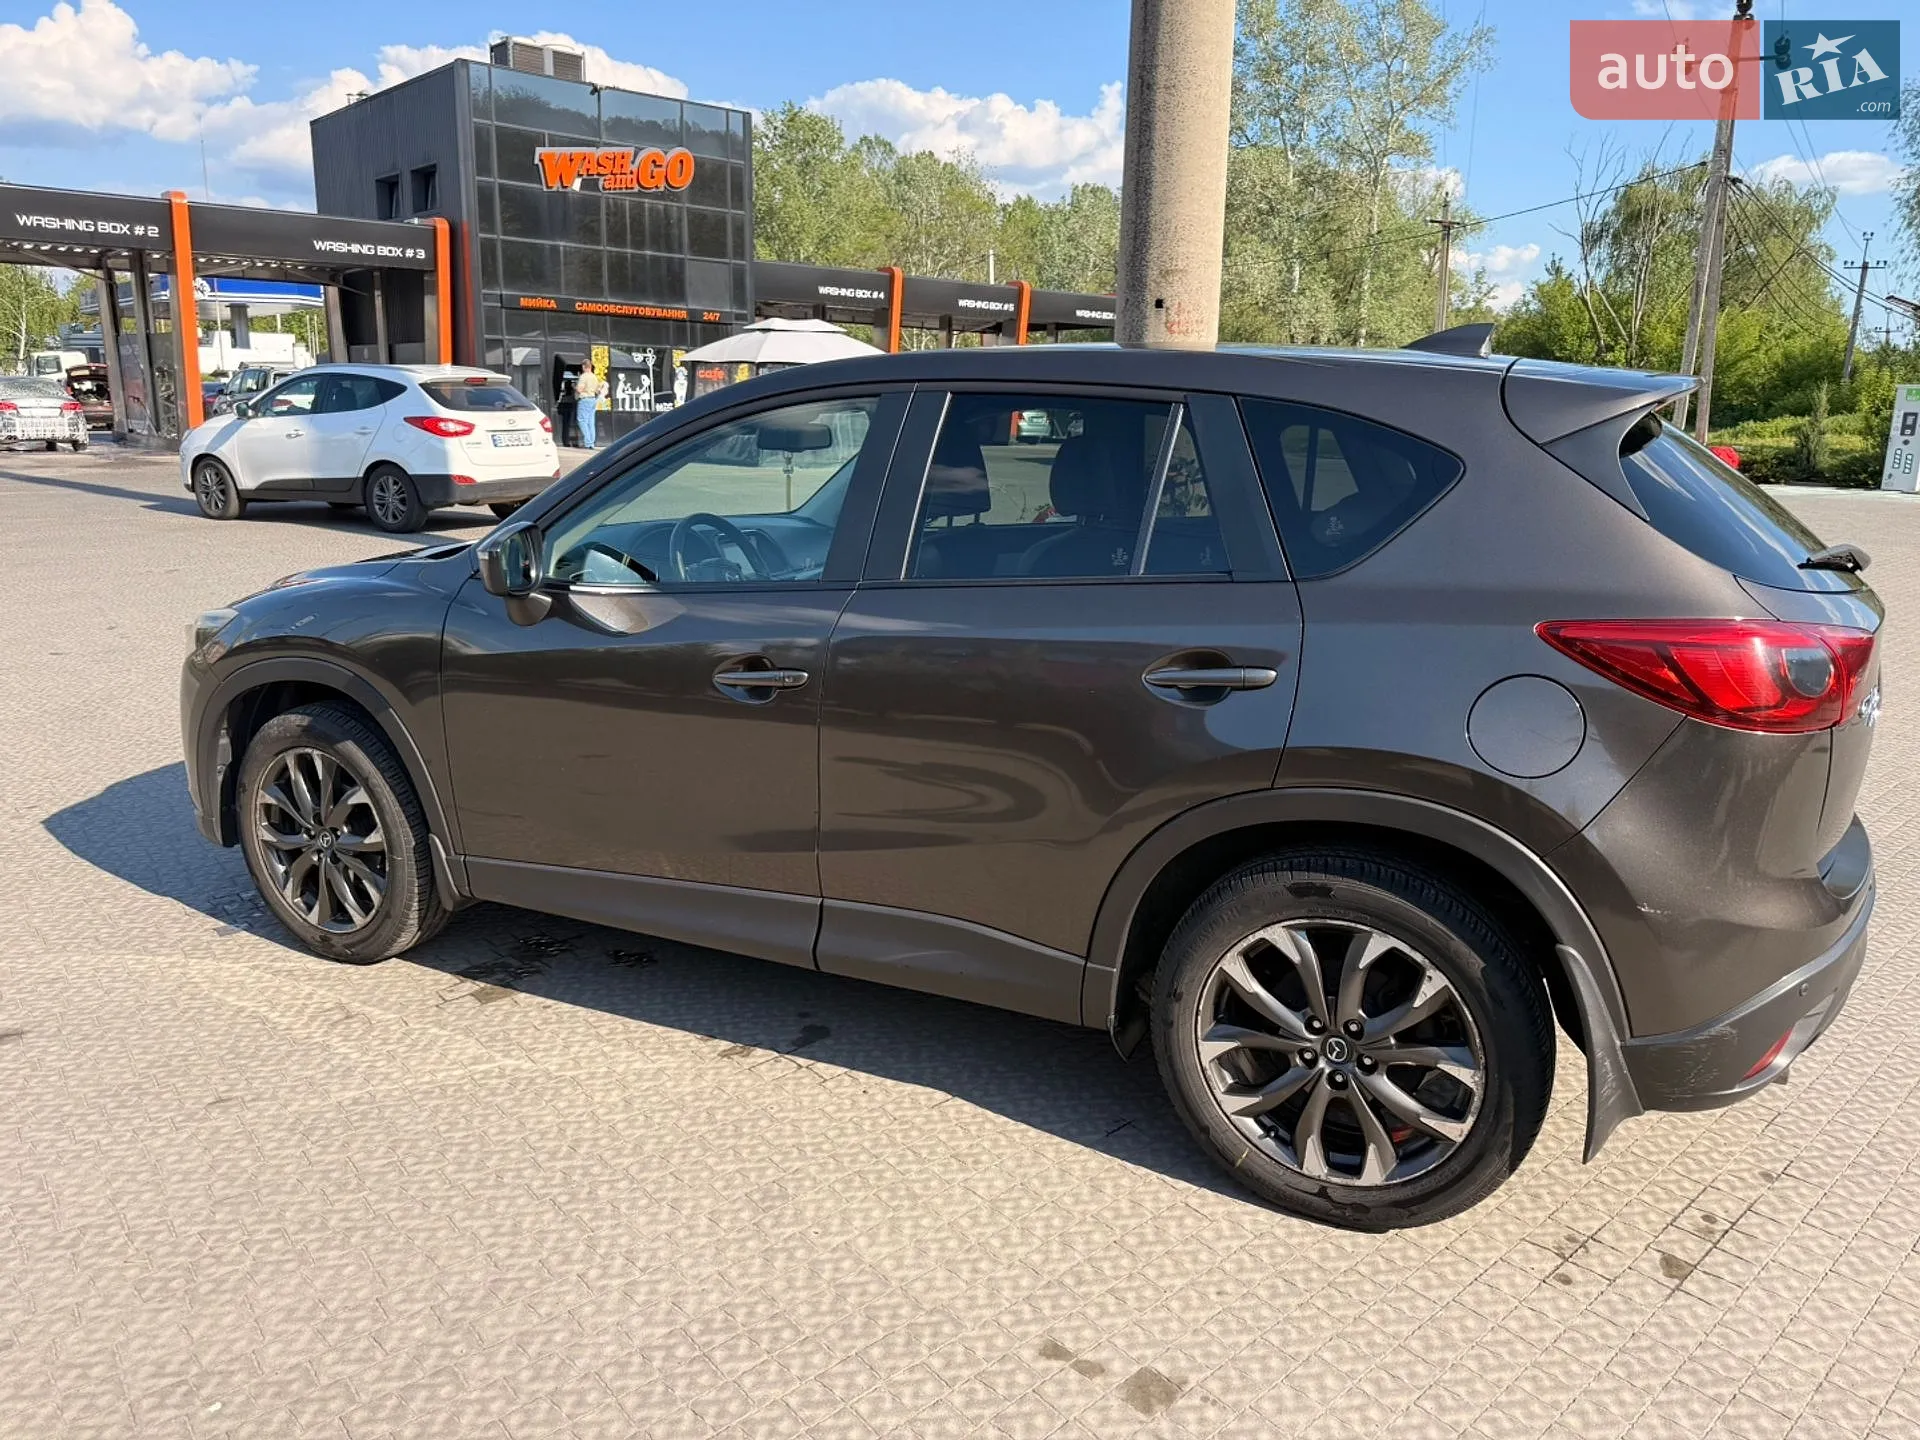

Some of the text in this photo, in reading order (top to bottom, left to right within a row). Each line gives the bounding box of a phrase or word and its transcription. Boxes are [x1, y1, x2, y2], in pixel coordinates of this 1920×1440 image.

[539, 149, 695, 191] WASH and GO
[15, 214, 95, 233] WASHING
[97, 221, 131, 235] BOX
[313, 239, 375, 255] WASHING
[376, 245, 403, 257] BOX
[817, 285, 855, 298] WASHING
[855, 289, 872, 299] BOX
[520, 296, 721, 321] МИЙКА САМООБСЛУГОВУВАННЯ 24/7
[957, 299, 989, 309] WASHING
[989, 301, 1003, 311] BOX
